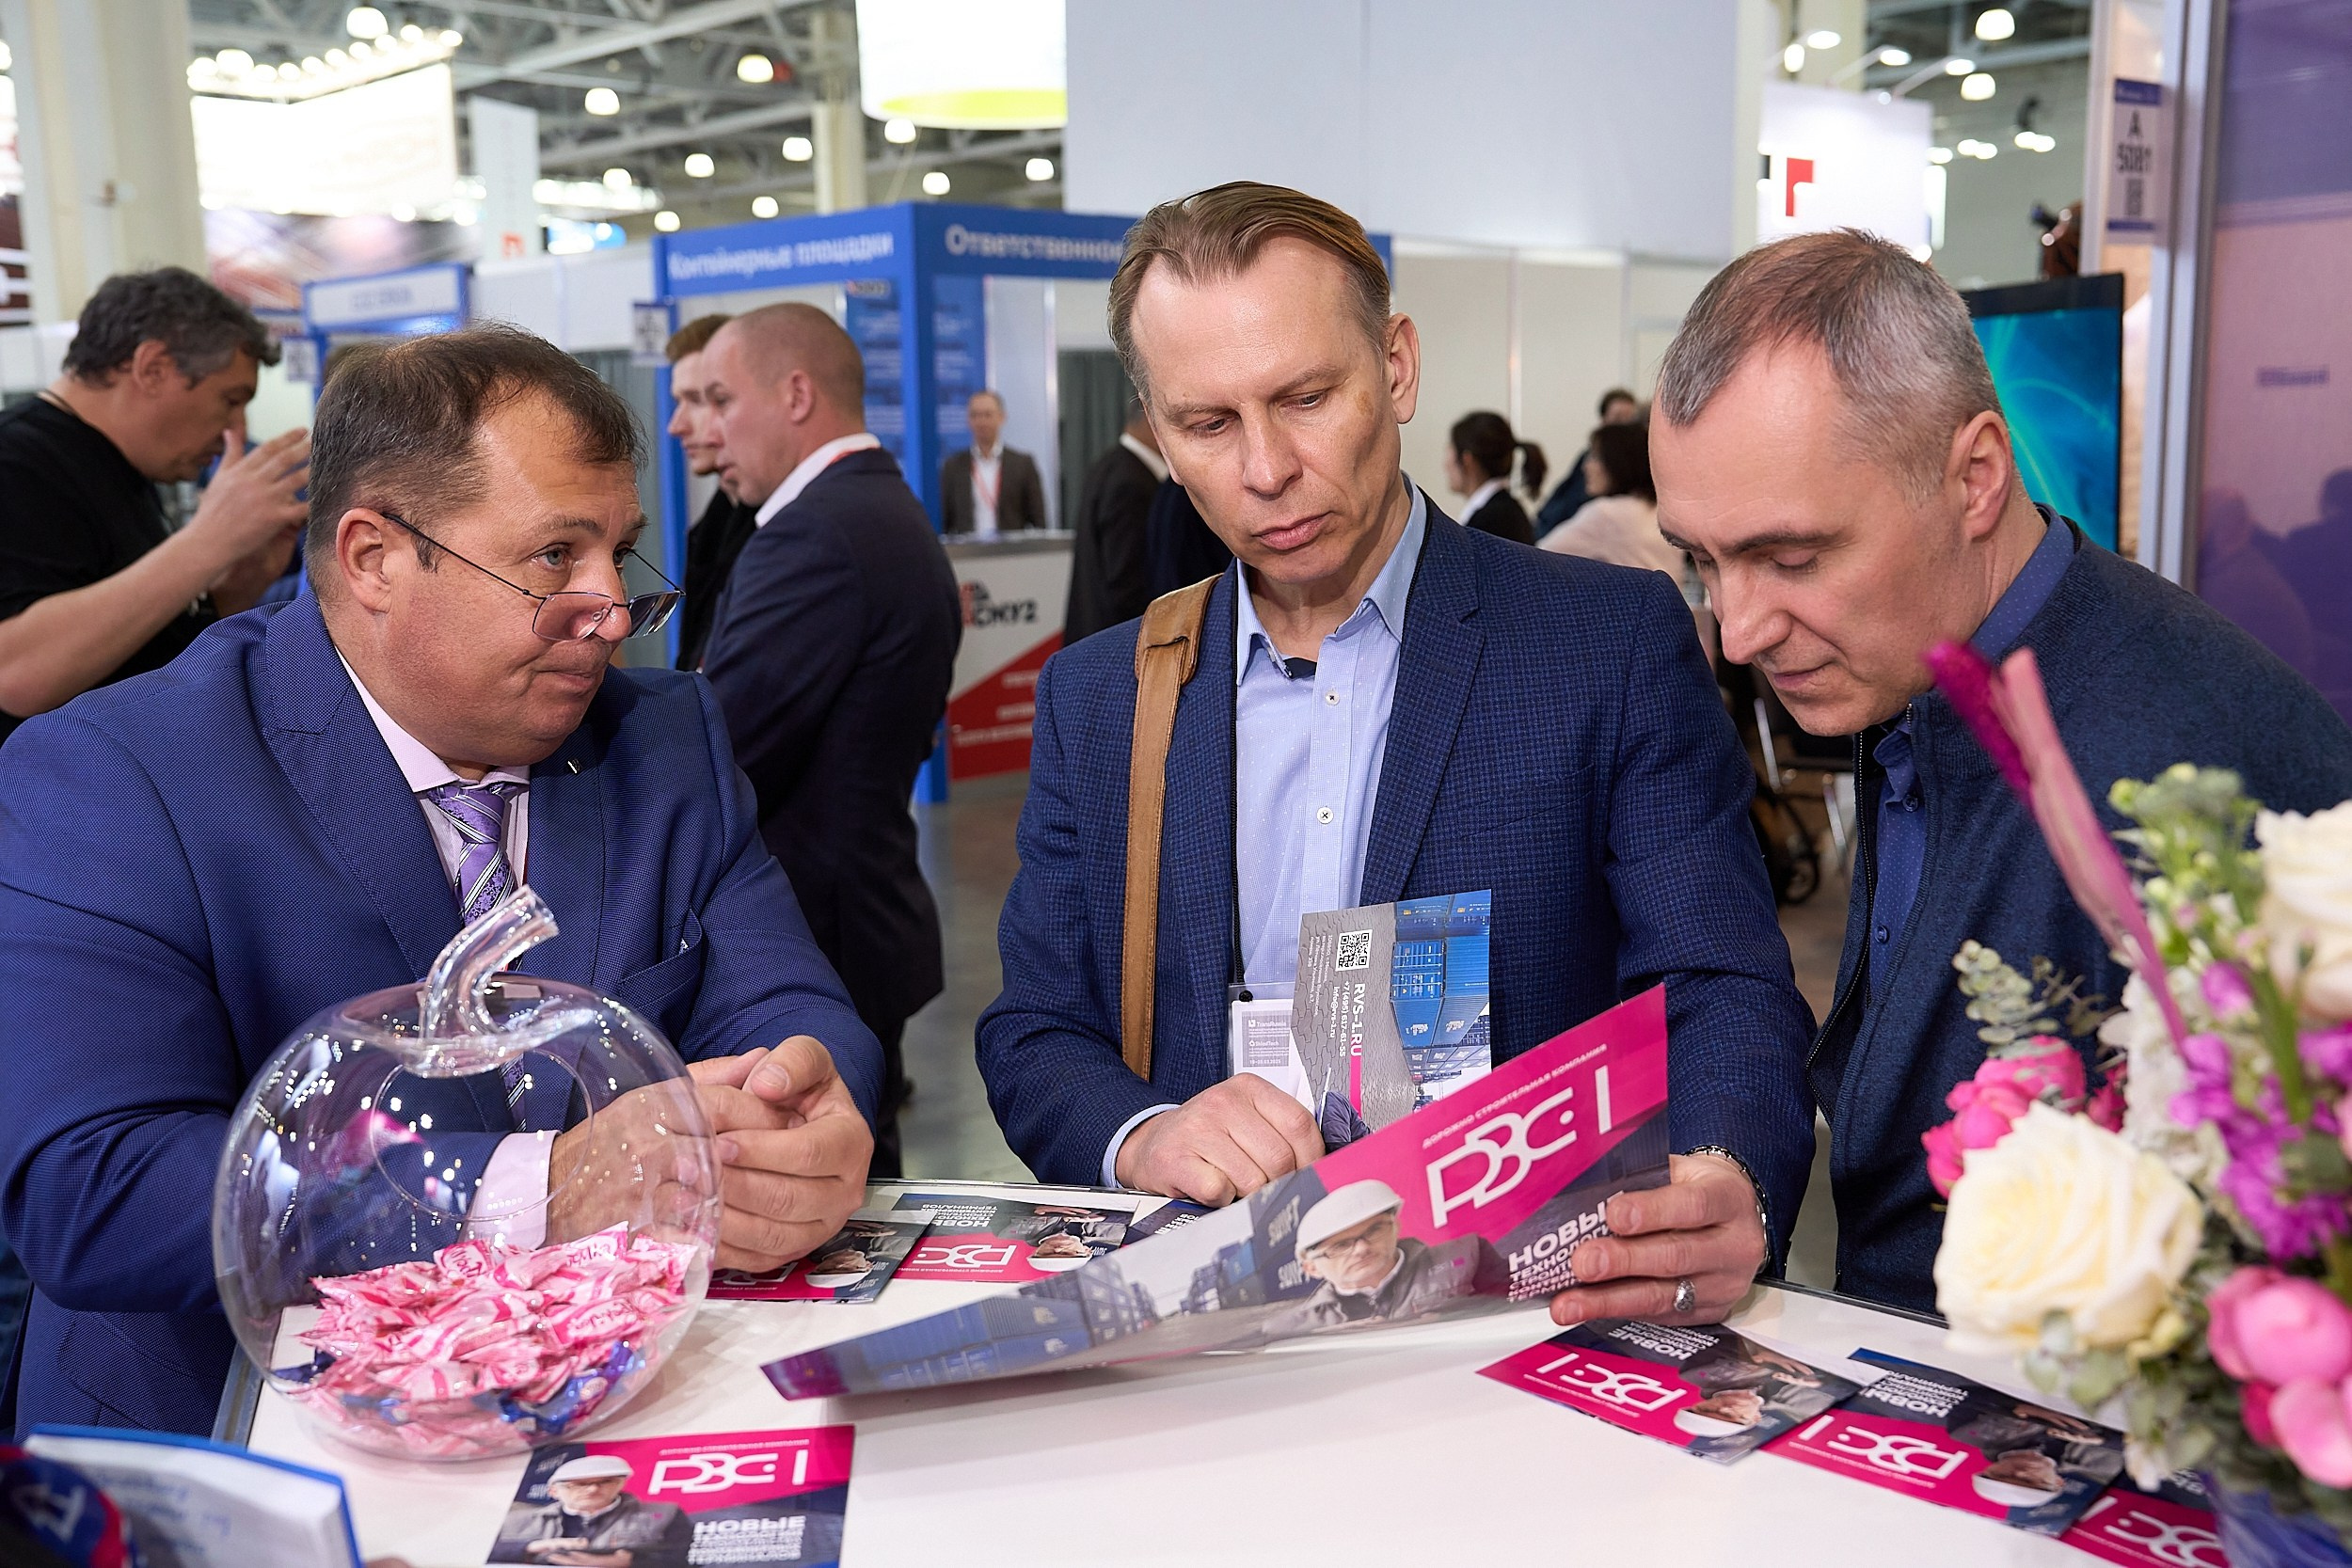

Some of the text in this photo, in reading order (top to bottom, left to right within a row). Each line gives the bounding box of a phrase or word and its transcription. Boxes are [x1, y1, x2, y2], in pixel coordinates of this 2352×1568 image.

[1339, 981, 1351, 1057] +7 (495) 617-61-55
[1350, 983, 1366, 1056] RVS-1.RU
[1422, 1043, 1608, 1149] ДОРОЖНО СТРОИТЕЛЬНАЯ КОМПАНИЯ
[1508, 1190, 1625, 1273] НОВЫ
[1608, 1328, 1692, 1360] НОВЫЕ
[692, 1515, 807, 1534] НОВЫЕ
